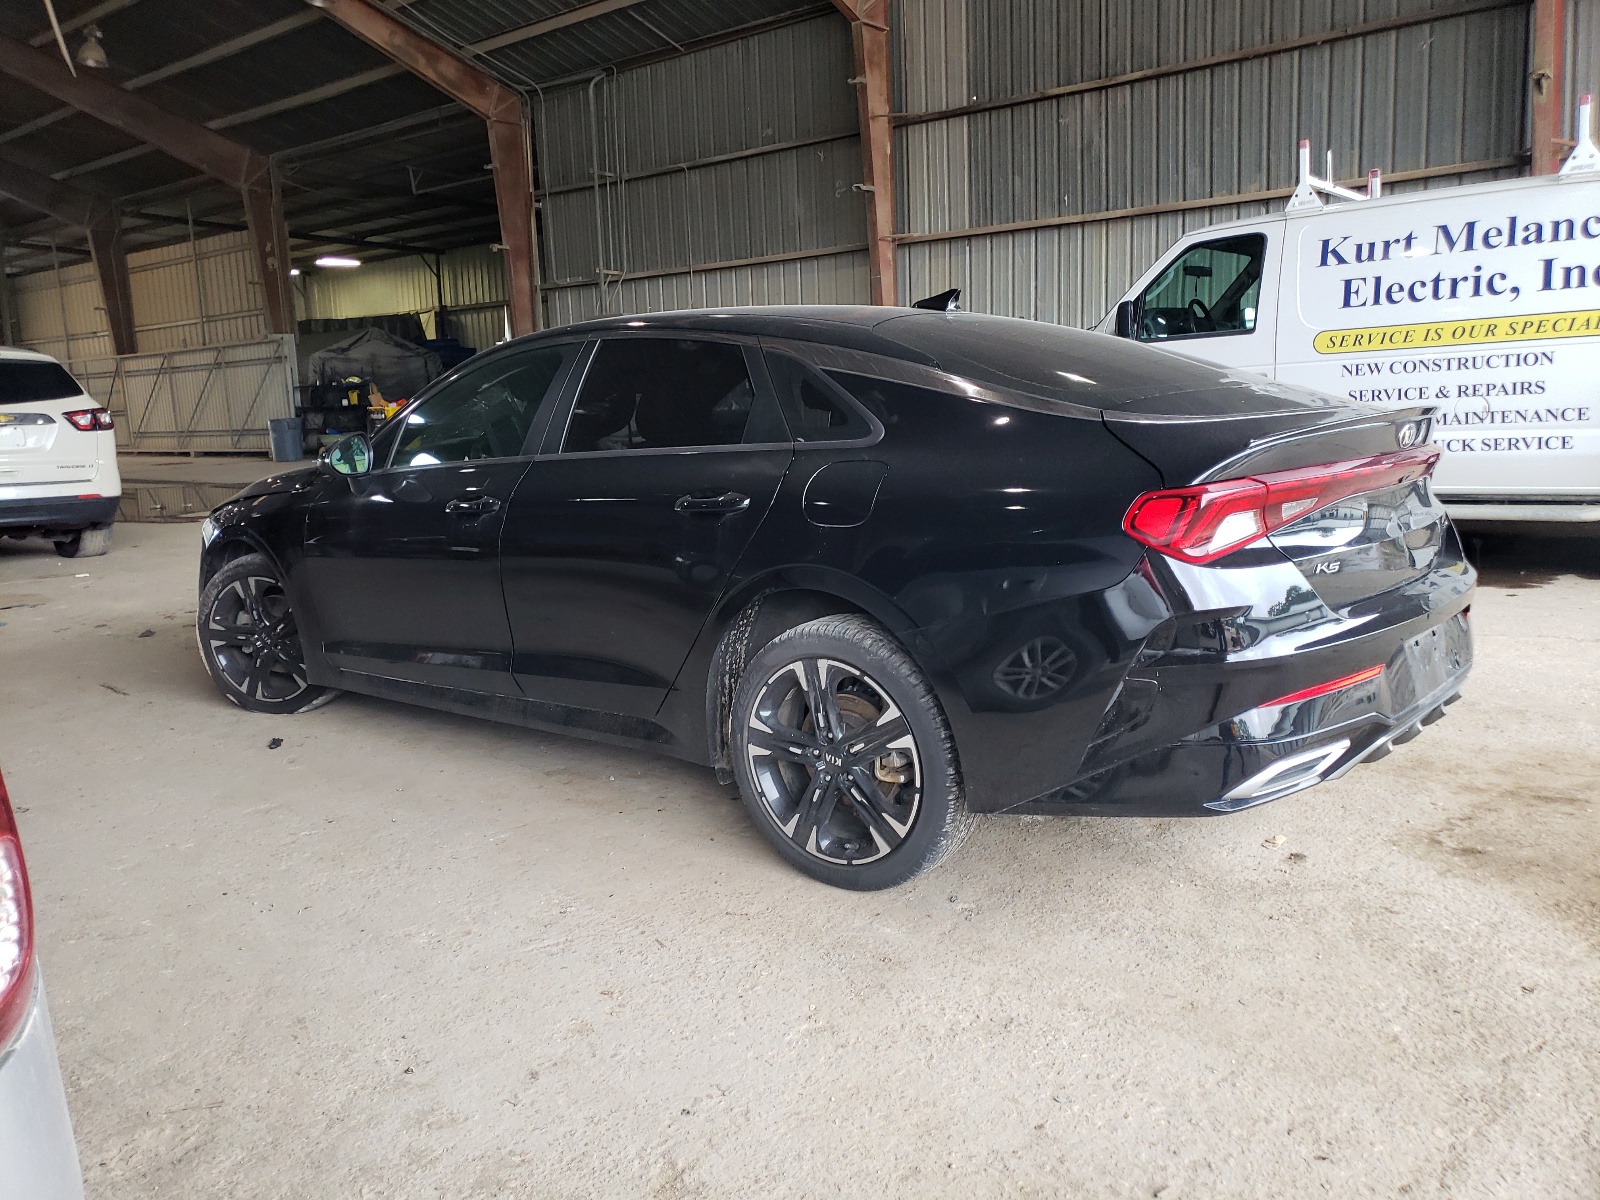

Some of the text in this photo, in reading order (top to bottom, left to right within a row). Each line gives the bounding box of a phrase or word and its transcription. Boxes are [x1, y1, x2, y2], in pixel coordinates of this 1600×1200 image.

[1315, 215, 1600, 268] Kurt Melanc
[1338, 265, 1521, 309] Electric,
[1326, 329, 1416, 349] SERVICE
[1423, 327, 1444, 342] IS
[1451, 323, 1498, 340] OUR
[1341, 351, 1555, 377] NEW CONSTRUCTION
[1348, 380, 1546, 402] SERVICE & REPAIRS
[1435, 407, 1590, 426] MAINTENANCE
[1480, 436, 1574, 451] SERVICE
[1314, 561, 1341, 574] K5
[825, 752, 842, 767] KIA
